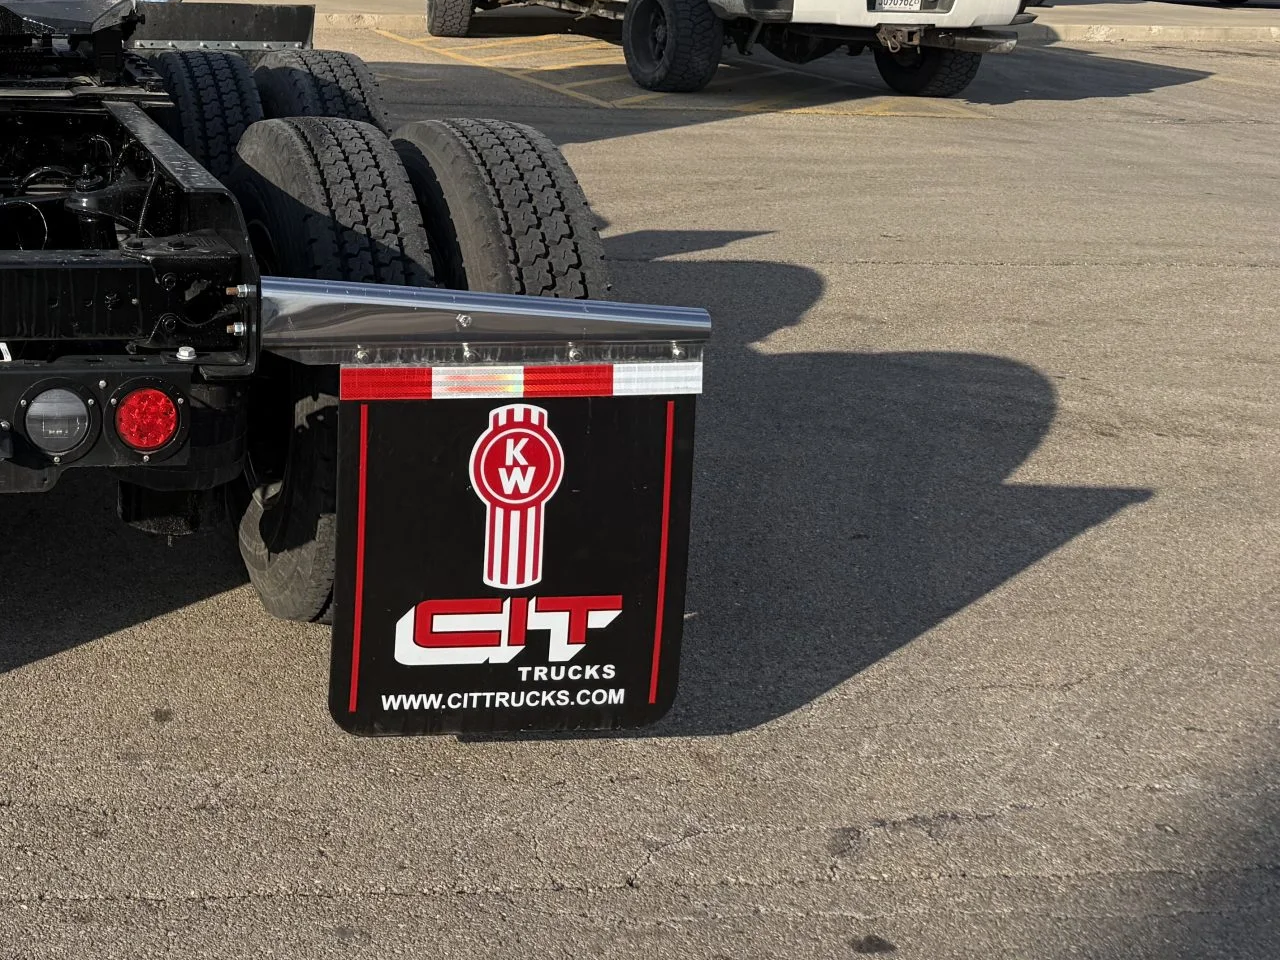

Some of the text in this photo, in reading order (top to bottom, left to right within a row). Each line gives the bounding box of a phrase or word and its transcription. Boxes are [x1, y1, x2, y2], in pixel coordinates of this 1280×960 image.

[394, 594, 623, 665] CIT
[518, 664, 616, 681] TRUCKS
[381, 688, 625, 711] WWW.CITTRUCKS.COM
